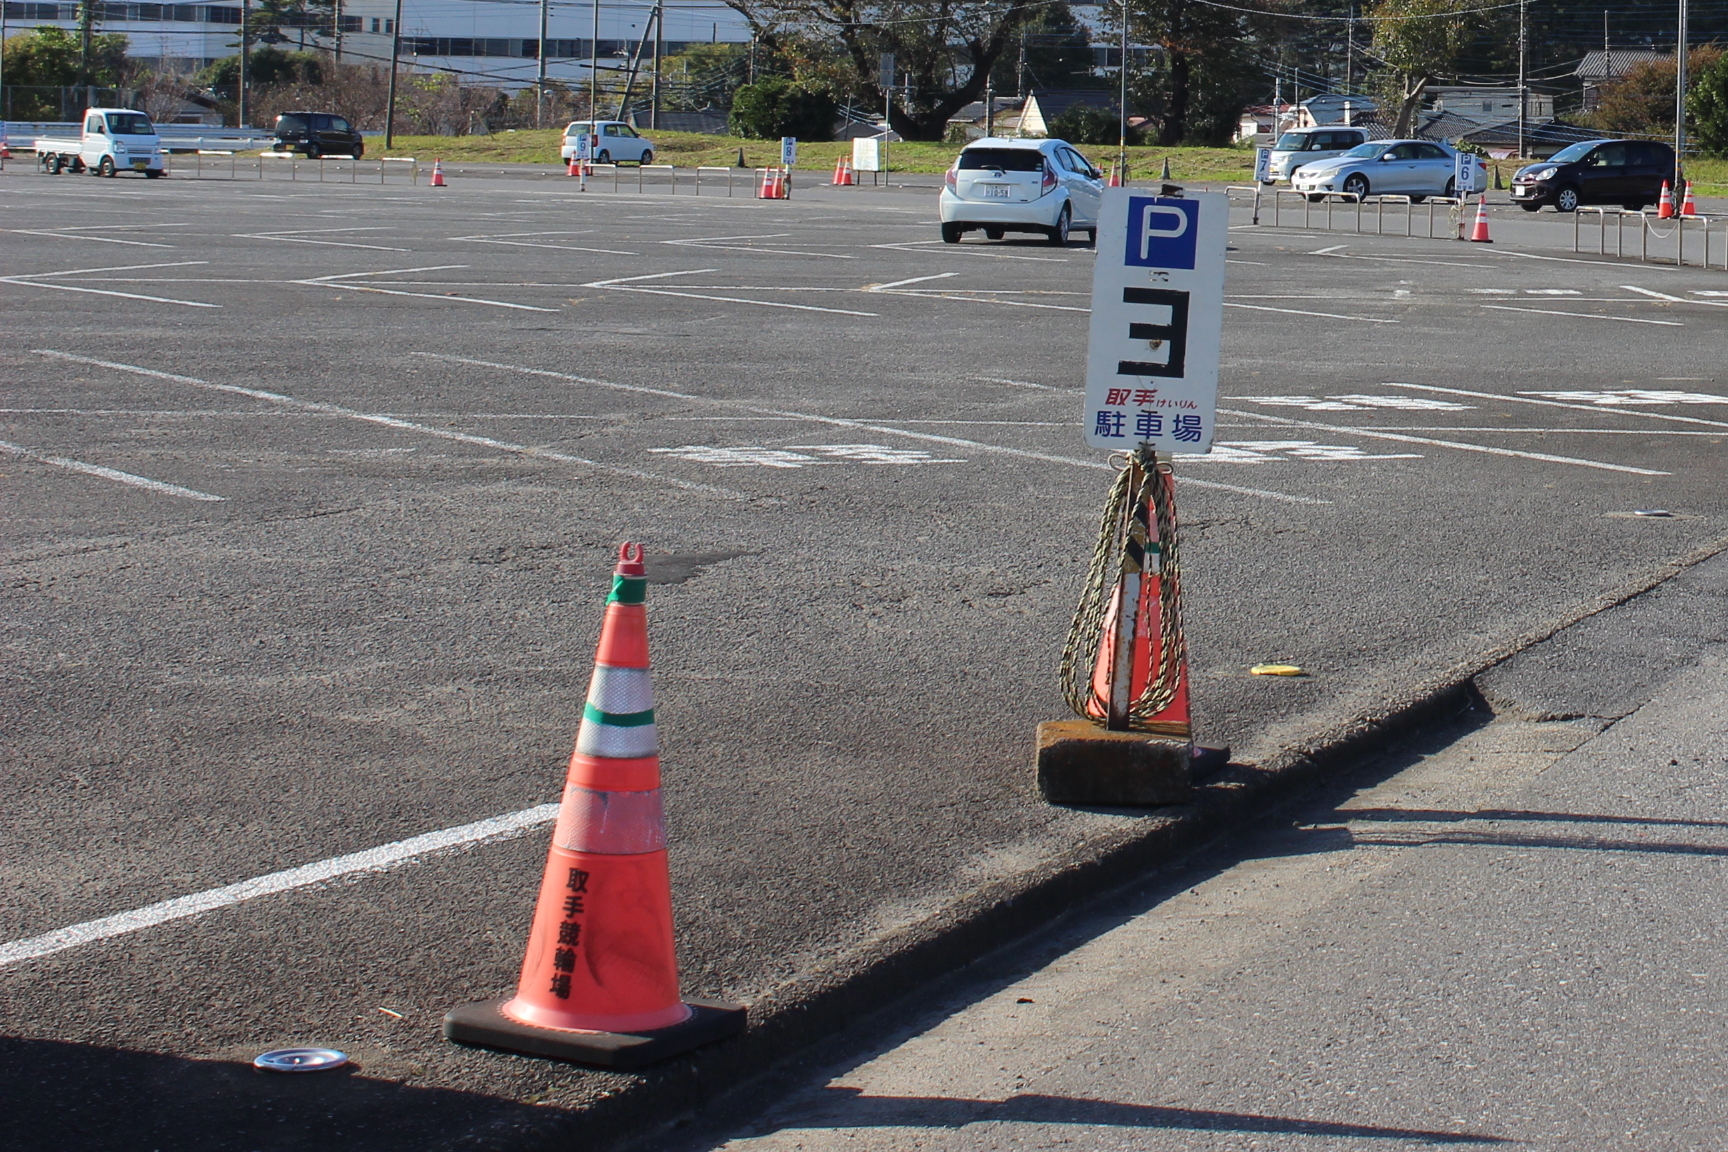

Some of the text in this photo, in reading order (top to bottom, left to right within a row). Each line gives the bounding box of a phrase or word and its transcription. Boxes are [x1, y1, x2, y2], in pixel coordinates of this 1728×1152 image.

[786, 147, 792, 156] 8
[1260, 160, 1267, 172] 7
[1461, 166, 1469, 180] 6
[1140, 204, 1188, 260] P
[1094, 410, 1203, 442] 駐車場
[549, 867, 590, 1000] 取手競輪場
